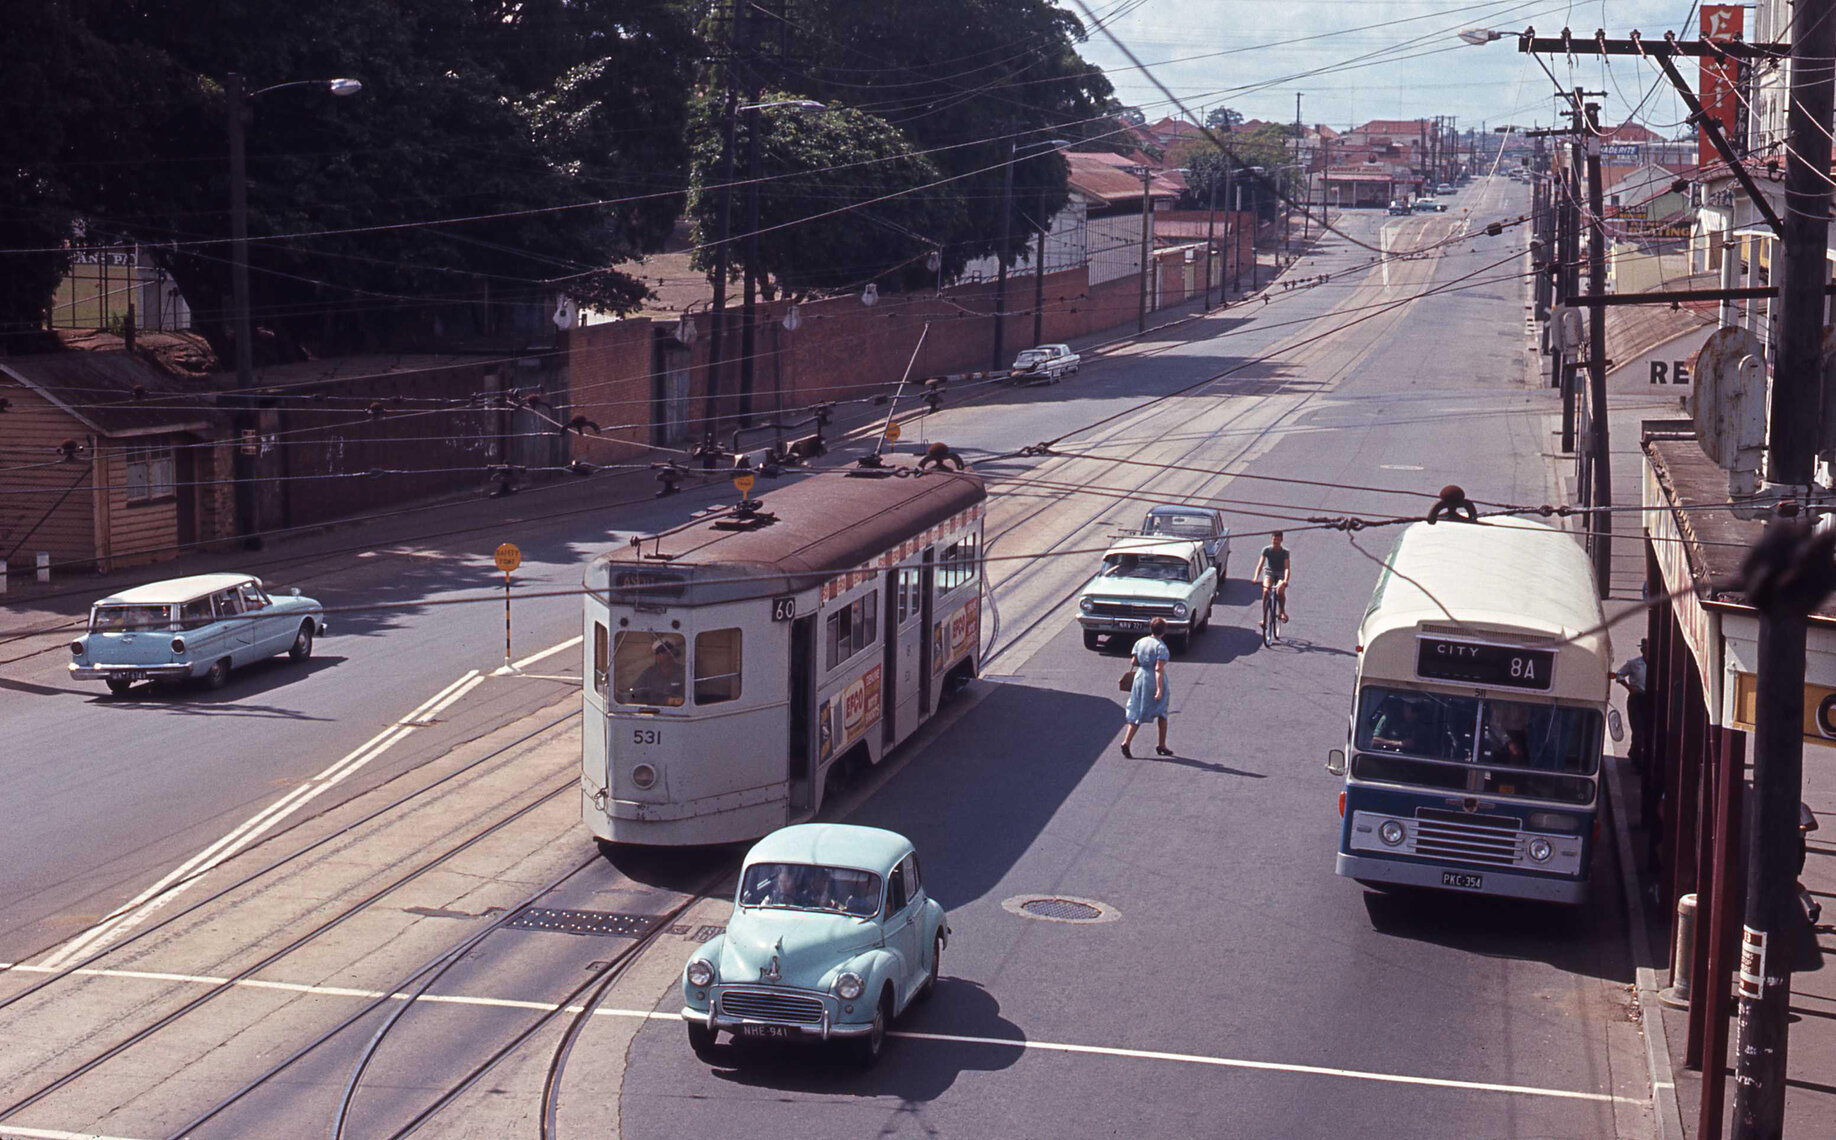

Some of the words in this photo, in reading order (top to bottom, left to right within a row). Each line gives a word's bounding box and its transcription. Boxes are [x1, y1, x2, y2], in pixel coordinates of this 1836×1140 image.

[776, 600, 795, 620] 60
[1437, 644, 1479, 657] CITY
[1510, 657, 1535, 679] 8A
[846, 687, 864, 721] EFCO
[633, 730, 661, 745] 531
